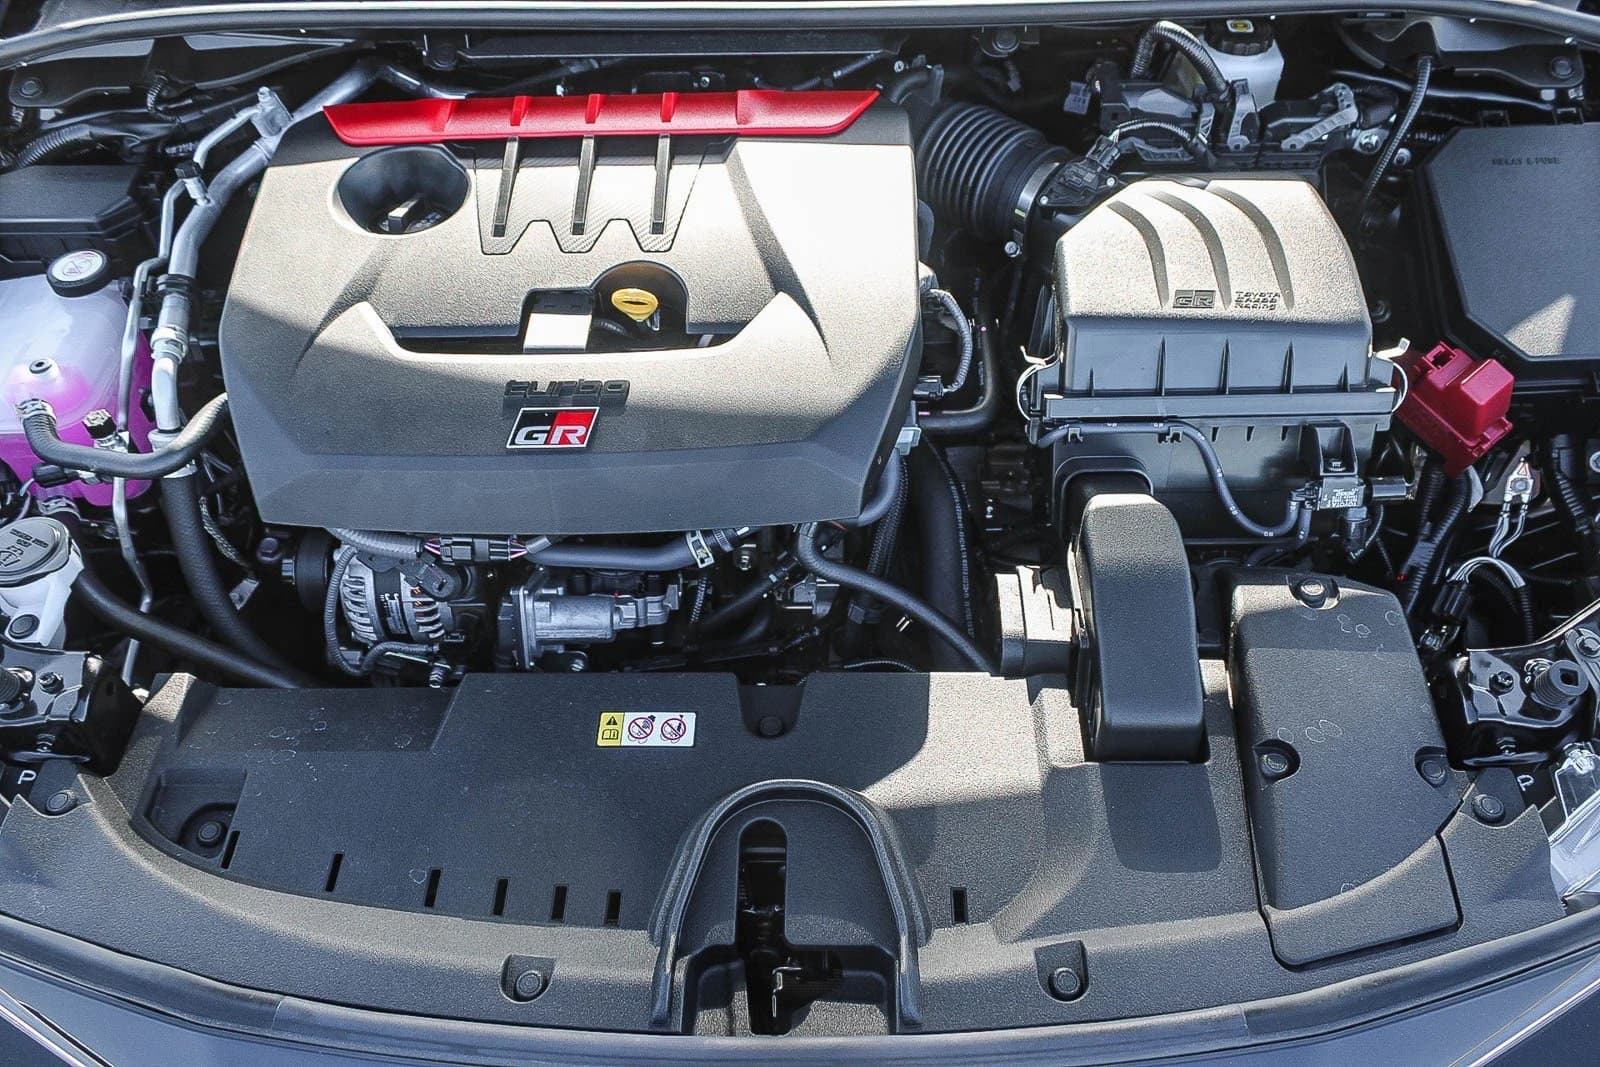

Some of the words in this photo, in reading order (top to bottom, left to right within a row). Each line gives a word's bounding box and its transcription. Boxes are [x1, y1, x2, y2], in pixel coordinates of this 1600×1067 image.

[514, 425, 588, 445] GR
[17, 769, 37, 785] P
[1516, 774, 1535, 792] P
